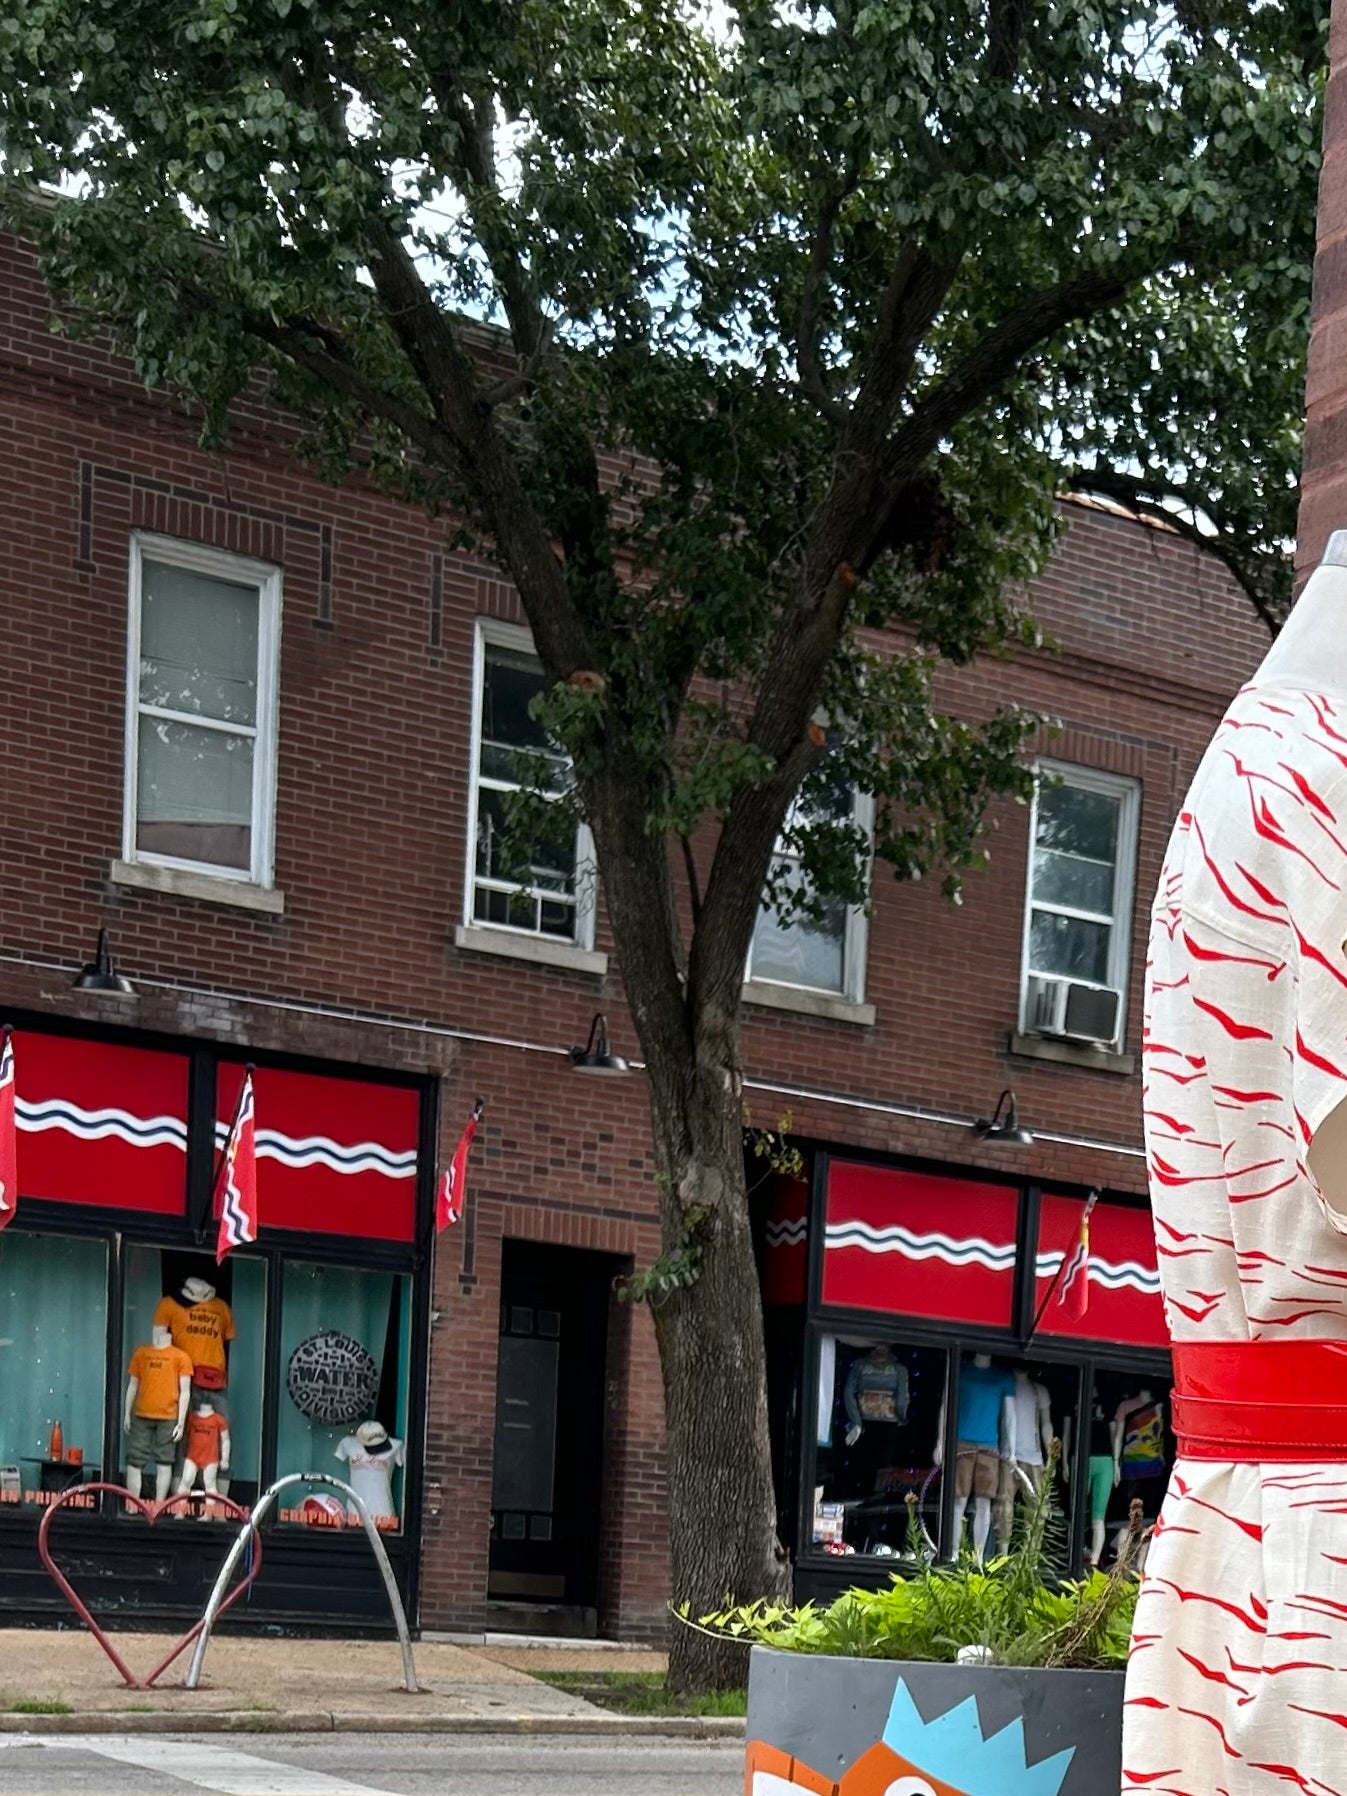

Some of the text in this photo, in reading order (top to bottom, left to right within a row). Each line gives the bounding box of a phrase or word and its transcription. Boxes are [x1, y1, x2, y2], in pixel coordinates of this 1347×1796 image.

[189, 1312, 217, 1325] baby
[186, 1325, 220, 1339] daddy
[324, 1339, 367, 1363] LOUIS
[299, 1366, 370, 1391] WATER
[299, 1391, 372, 1420] DIVISION
[280, 1509, 340, 1528] GRAPHIC
